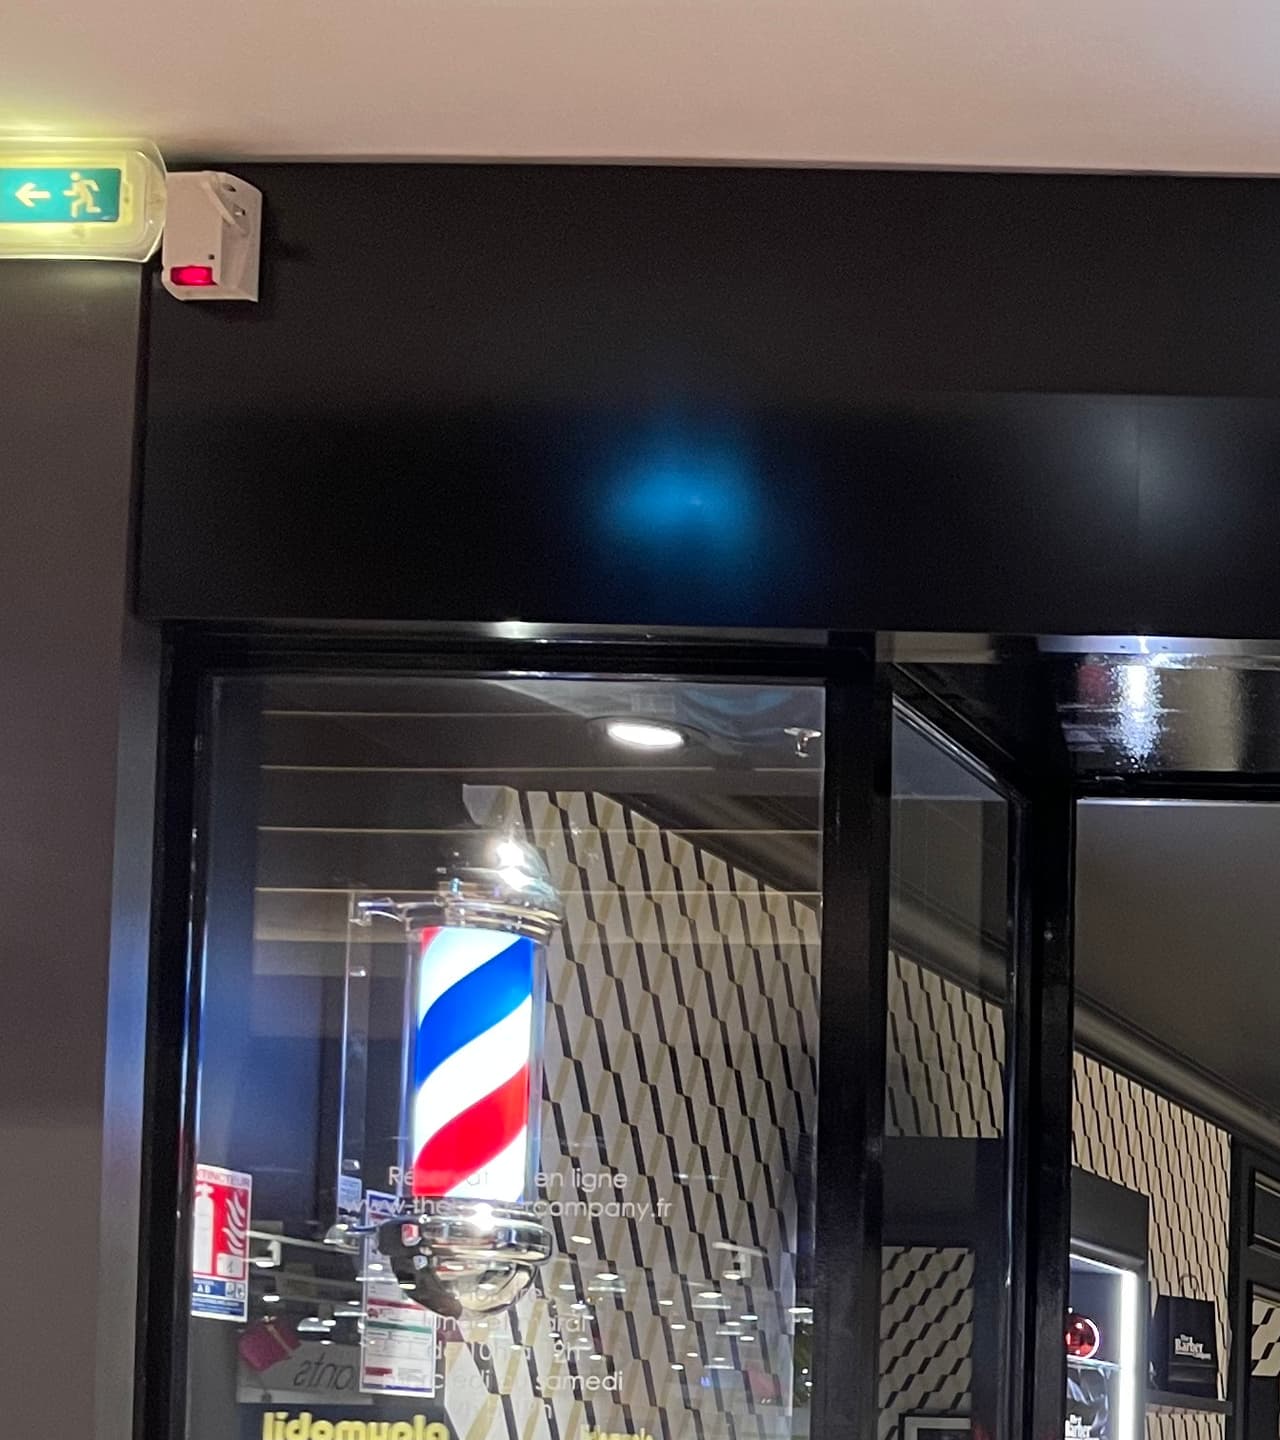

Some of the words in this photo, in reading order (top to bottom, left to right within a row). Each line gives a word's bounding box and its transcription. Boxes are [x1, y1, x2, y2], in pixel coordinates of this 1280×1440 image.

[534, 1171, 564, 1188] en
[572, 1167, 628, 1193] ligne
[535, 1371, 624, 1391] samedi
